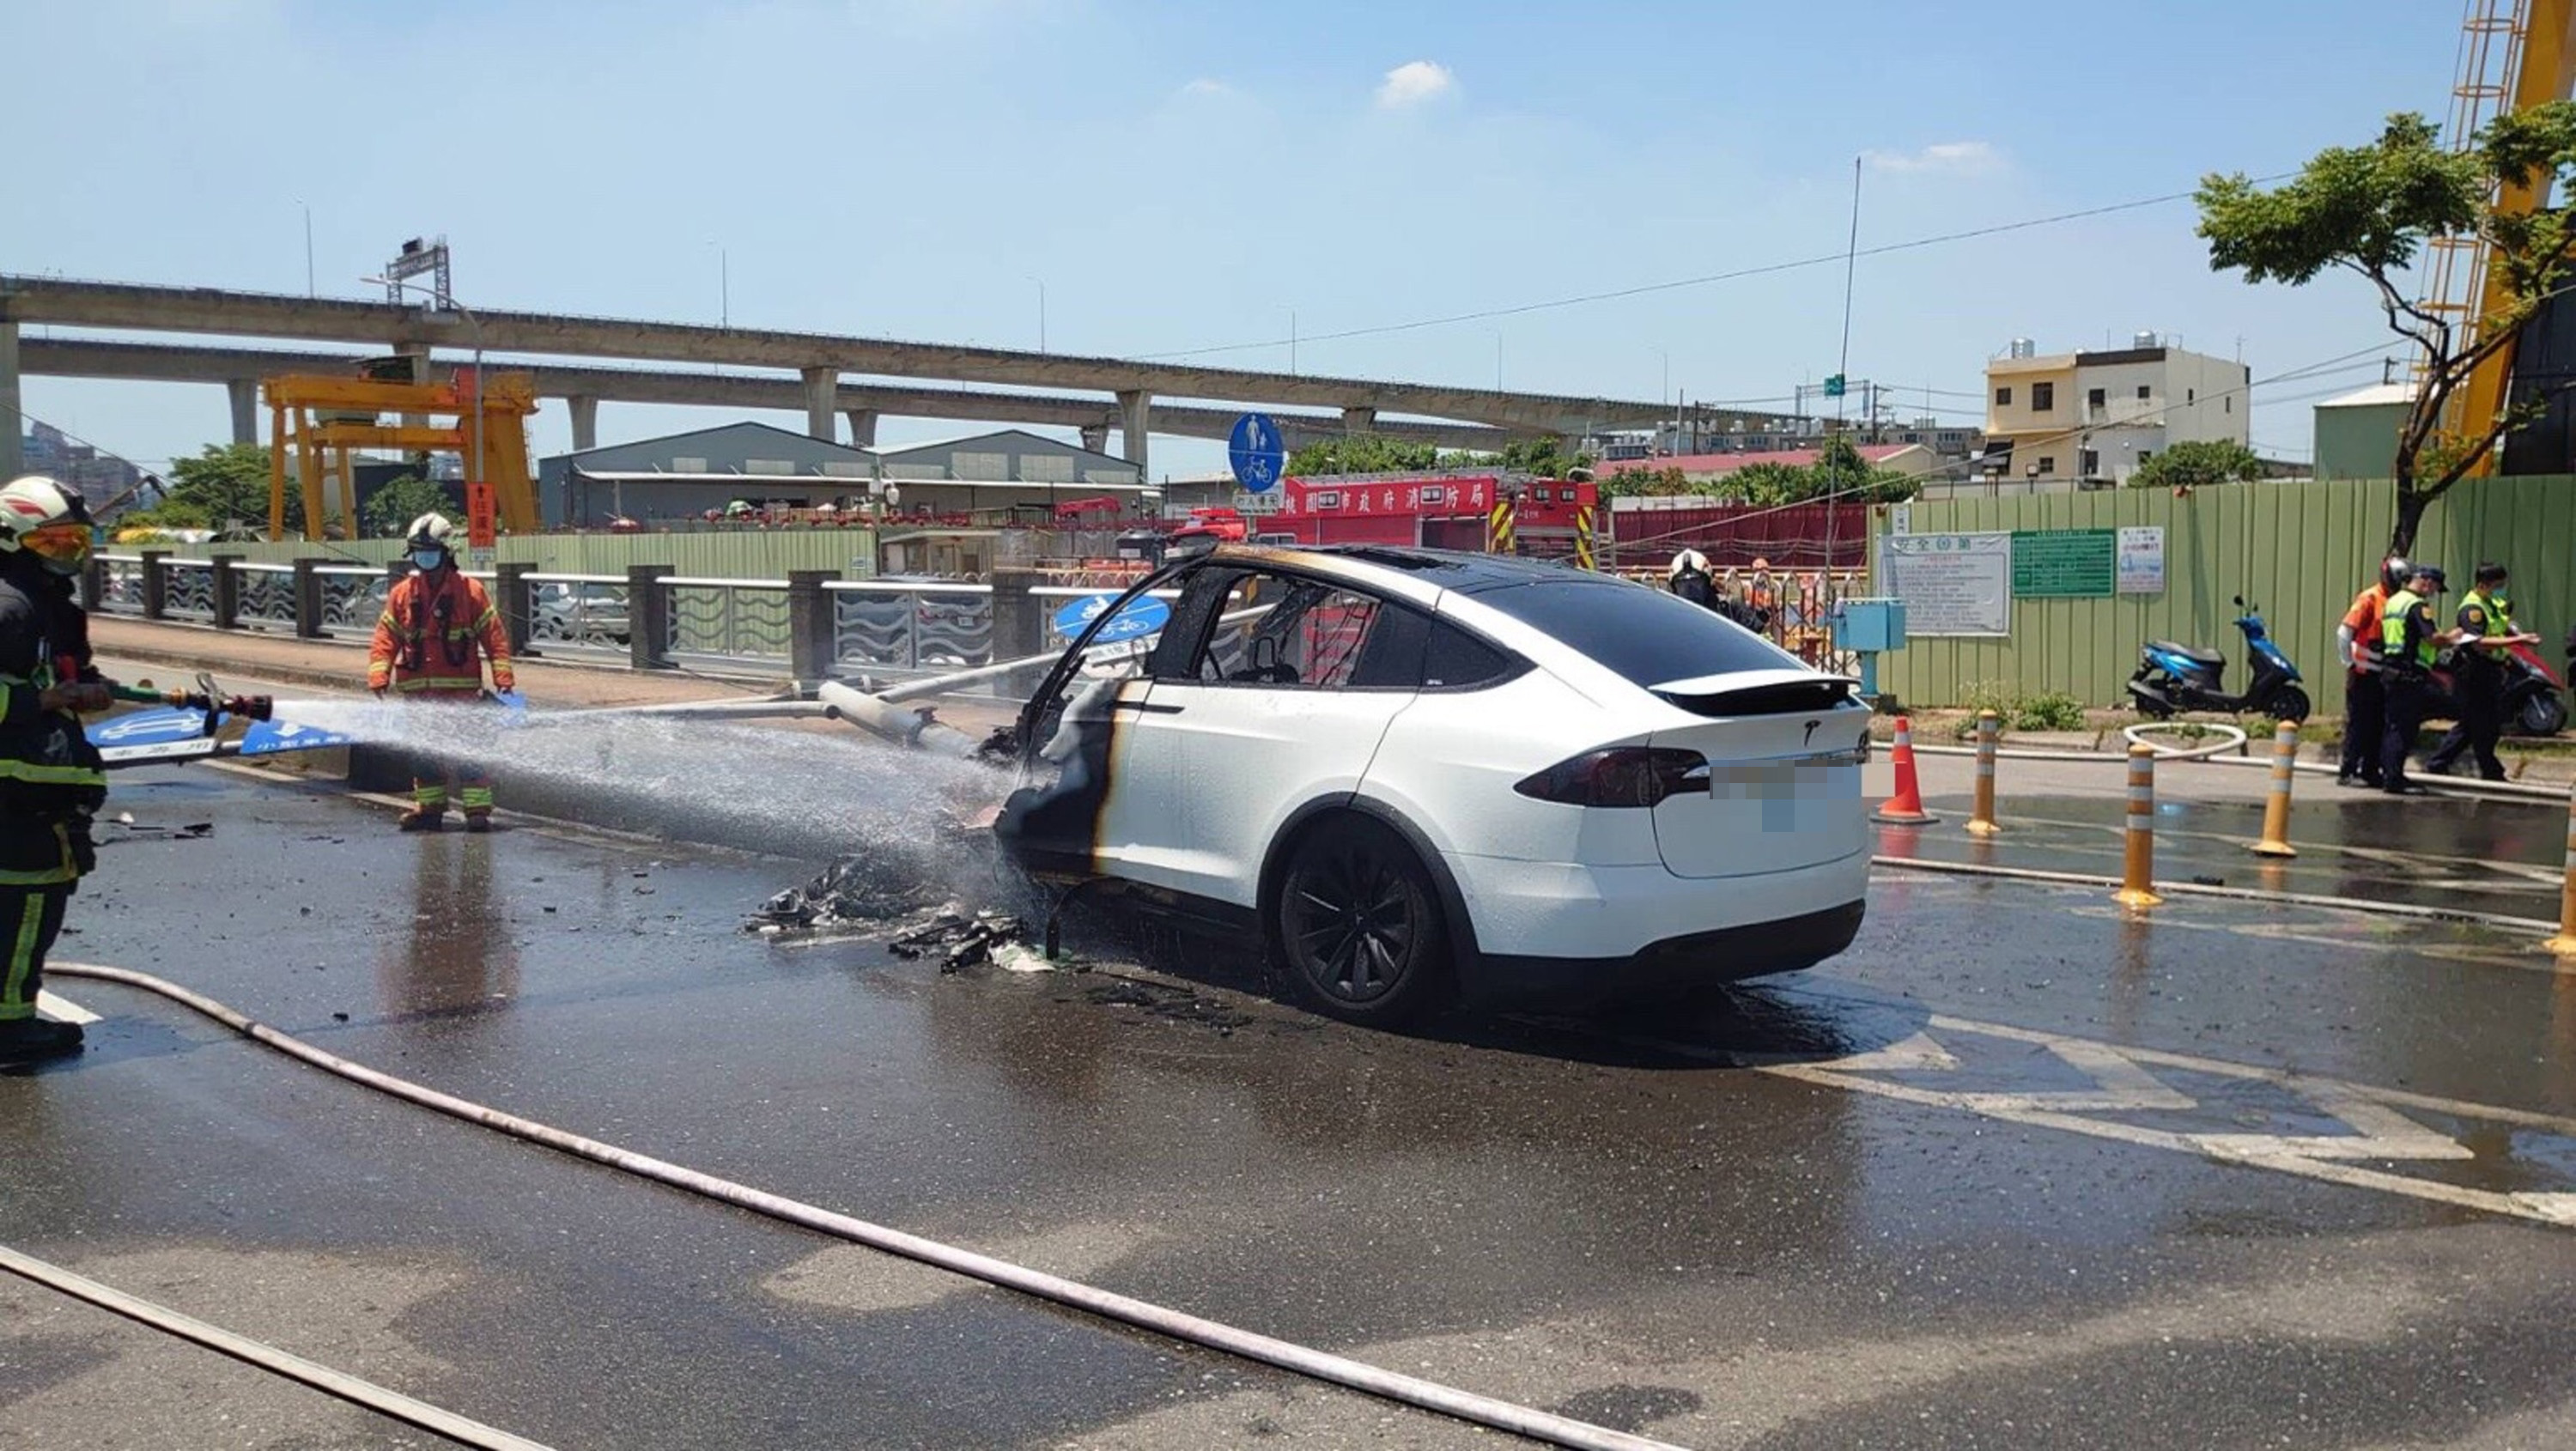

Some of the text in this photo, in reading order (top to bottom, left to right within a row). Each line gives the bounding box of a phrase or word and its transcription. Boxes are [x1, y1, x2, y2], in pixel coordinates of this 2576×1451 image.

[1285, 483, 1484, 514] 桃園市政府消防局
